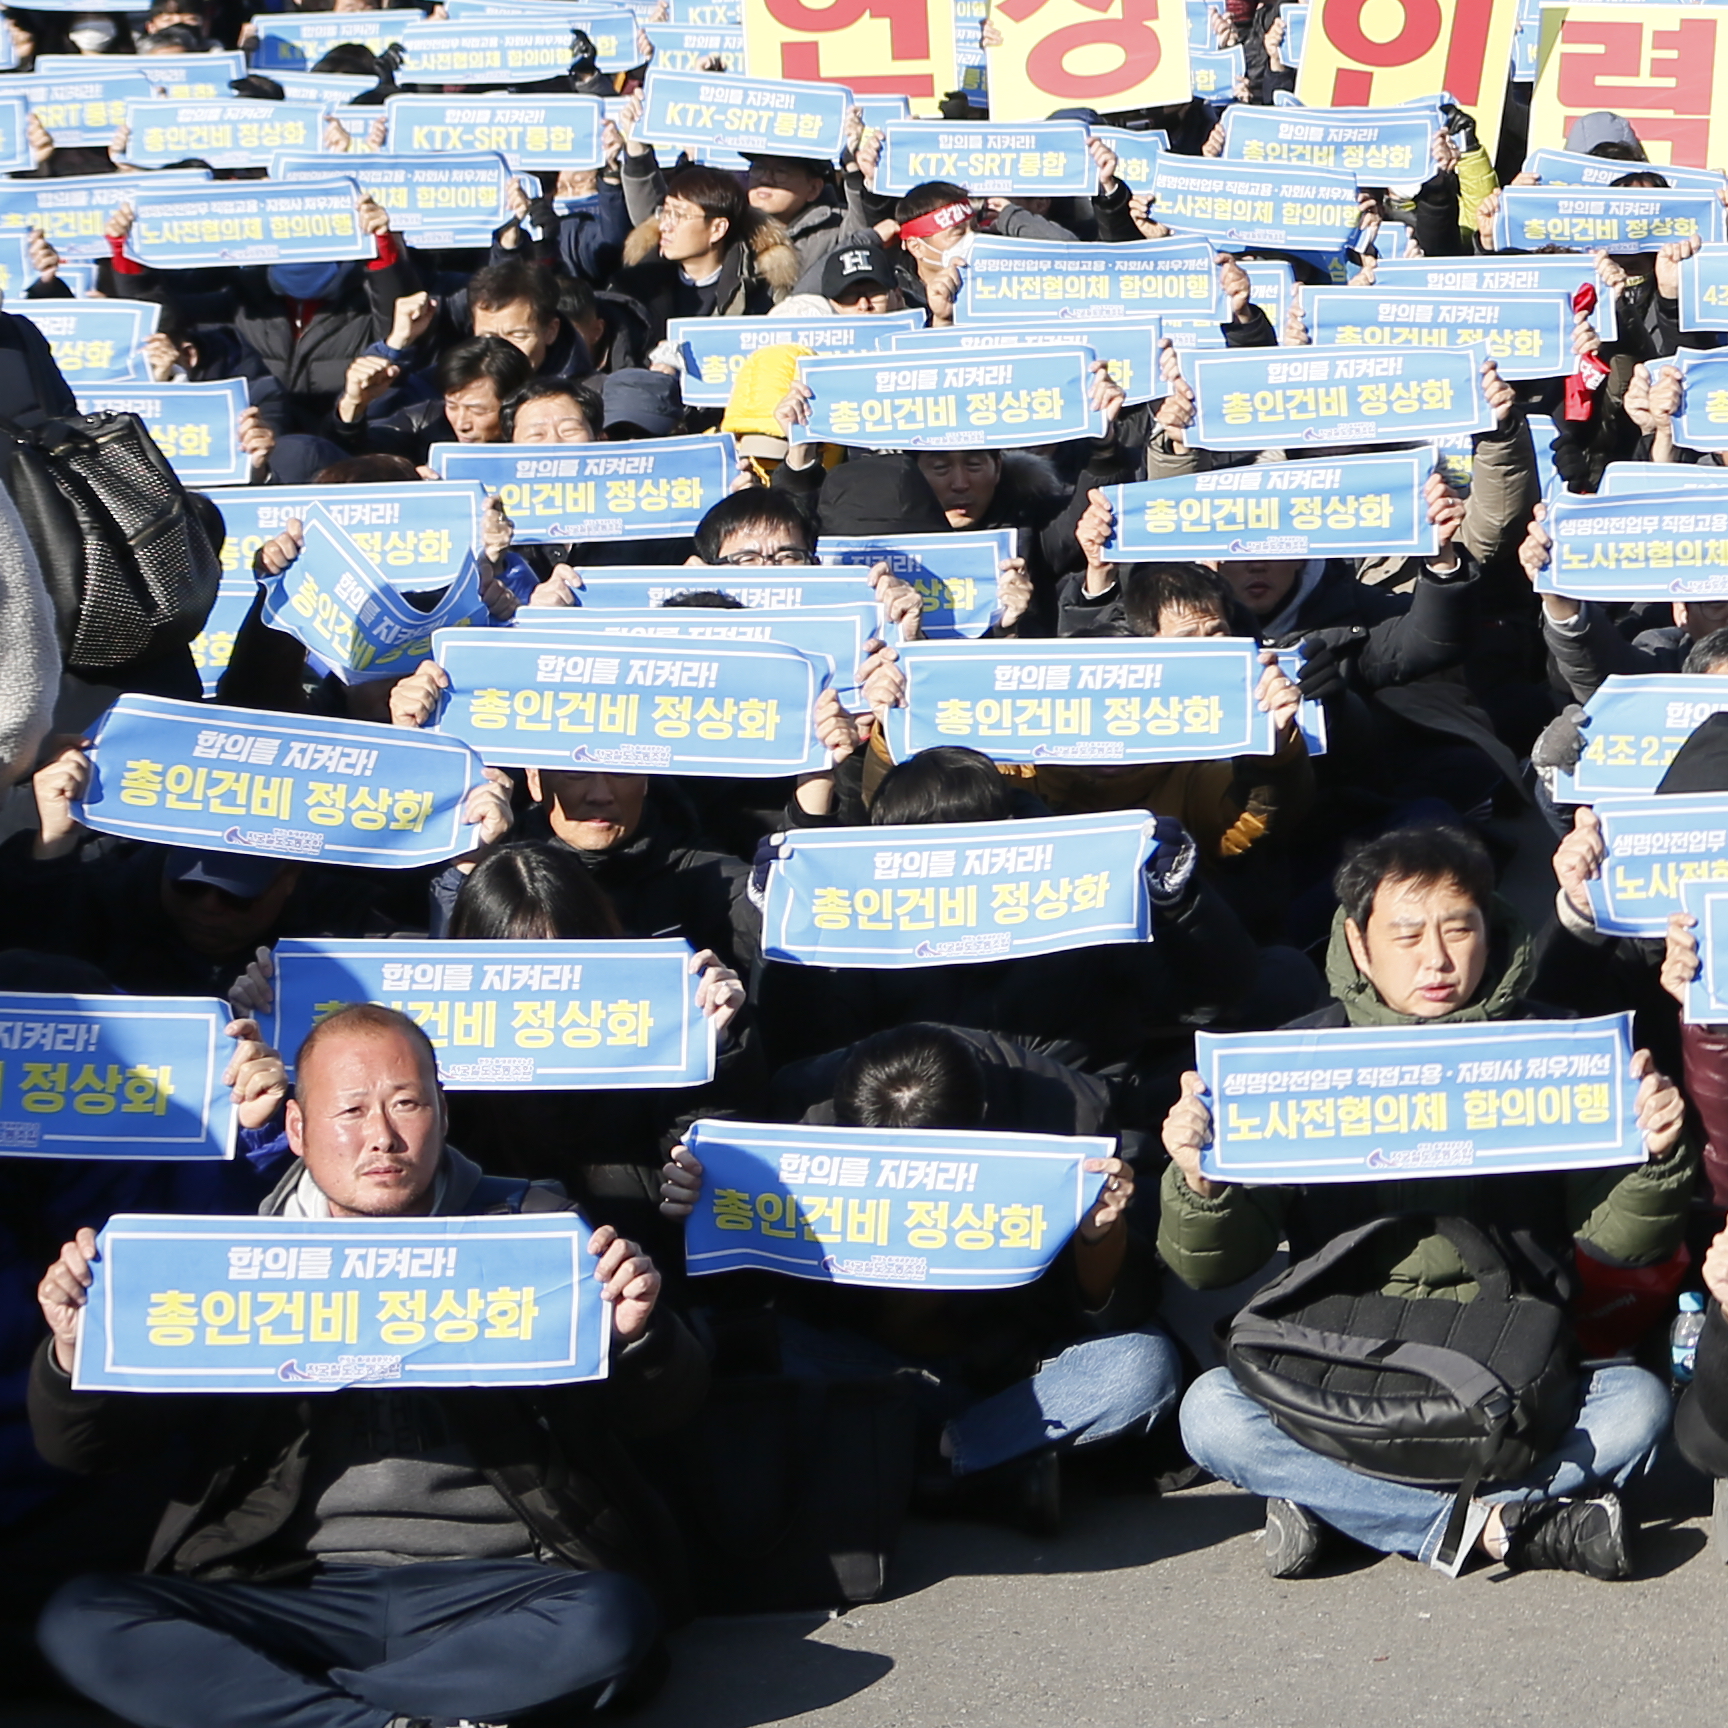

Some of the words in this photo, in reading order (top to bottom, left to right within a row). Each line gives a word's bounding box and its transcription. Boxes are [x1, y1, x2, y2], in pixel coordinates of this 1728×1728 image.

[1266, 358, 1331, 383] 합의를
[1221, 386, 1348, 424] 총인건비
[1358, 380, 1455, 416] 정상화
[536, 654, 622, 689] 합의를
[468, 687, 640, 739] 총인건비
[650, 693, 782, 743] 정상화
[191, 730, 284, 766] 합의를
[119, 758, 292, 821] 총인건비
[305, 782, 434, 835] 정상화
[1223, 1067, 1353, 1096] 생명안전업무
[1356, 1064, 1442, 1090] 직접고용
[1457, 1059, 1523, 1085] 자회사
[1526, 1053, 1610, 1081] 처우개선
[1227, 1092, 1447, 1141] 노사전협의체
[1463, 1082, 1610, 1131] 합의이행
[779, 1153, 871, 1190] 합의를
[712, 1187, 892, 1246] 총인건비
[904, 1197, 1049, 1252] 정상화
[227, 1246, 334, 1281] 합의를
[146, 1289, 360, 1347] 총인건비
[376, 1286, 539, 1345] 정상화
